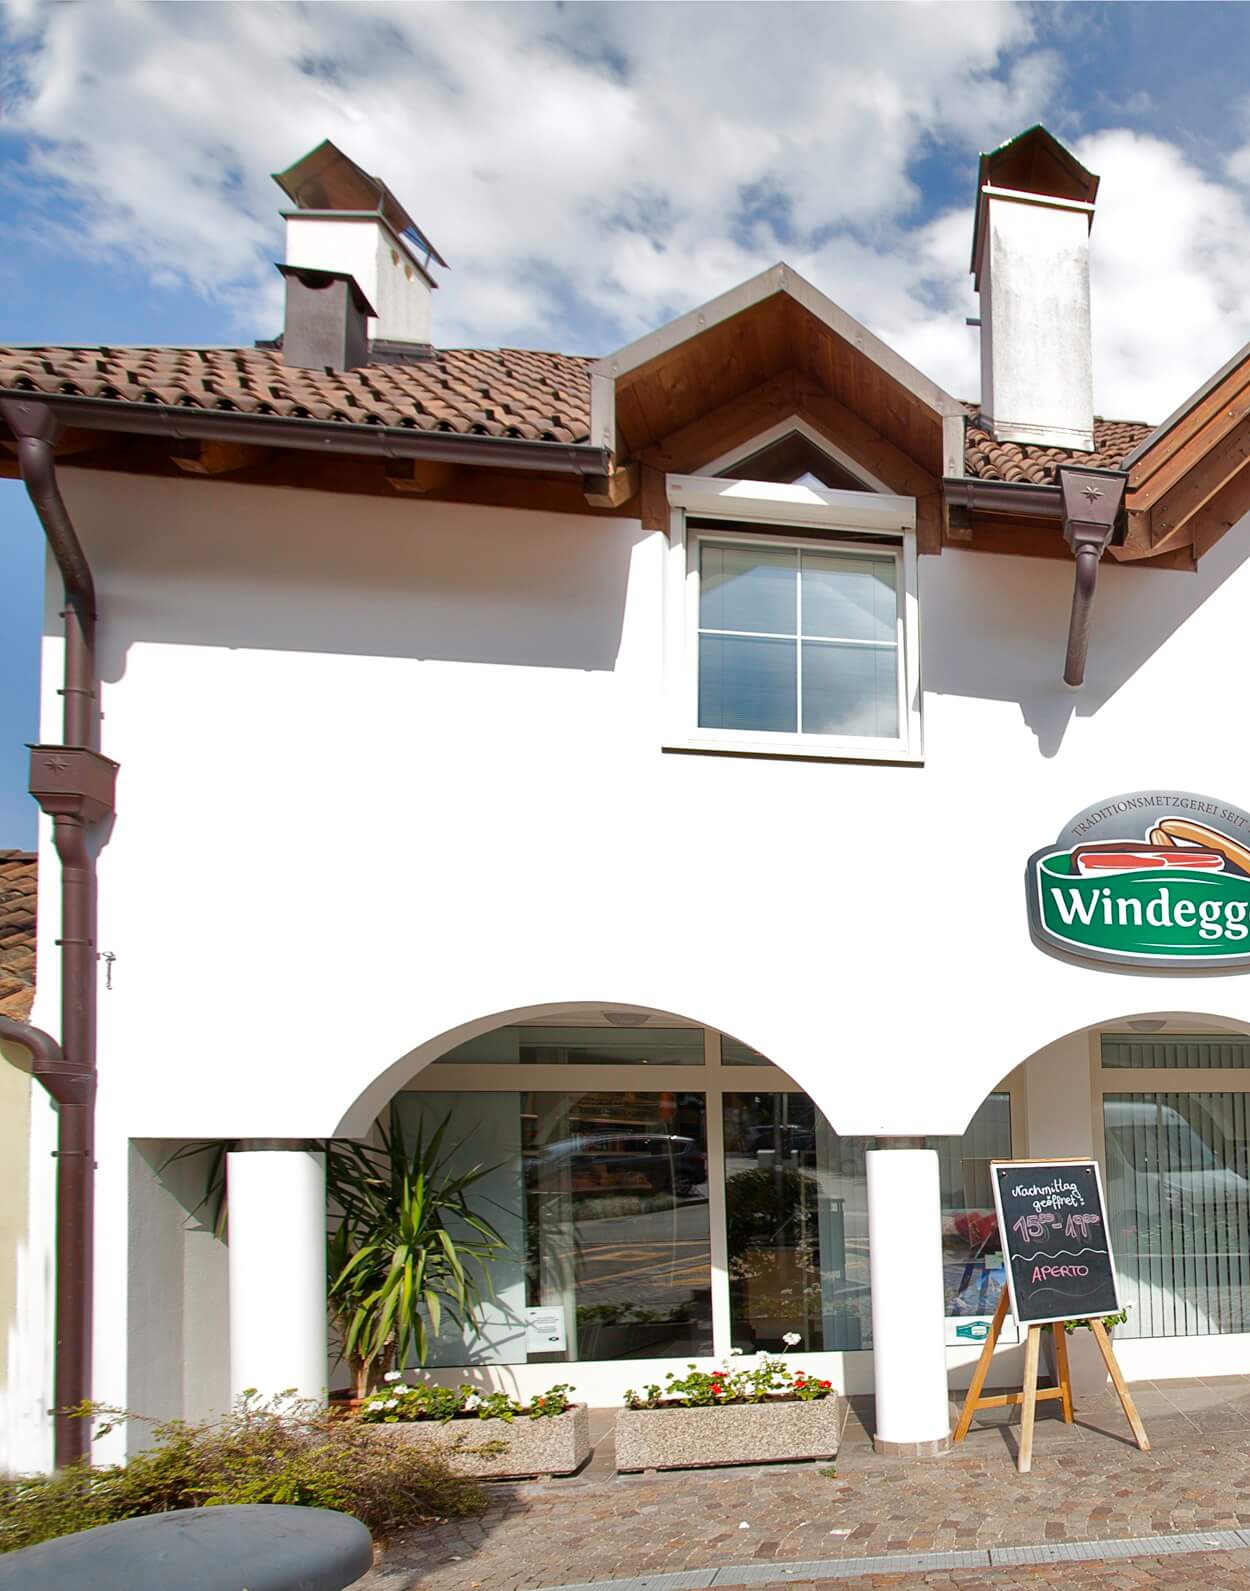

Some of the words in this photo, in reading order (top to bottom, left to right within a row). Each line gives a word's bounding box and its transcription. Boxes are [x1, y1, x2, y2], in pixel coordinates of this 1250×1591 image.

[1071, 796, 1218, 838] TRADITIONSMETZGEREI
[1220, 809, 1249, 829] SEIT
[1012, 1178, 1081, 1198] Nachmittag
[1032, 1265, 1089, 1284] APERTO
